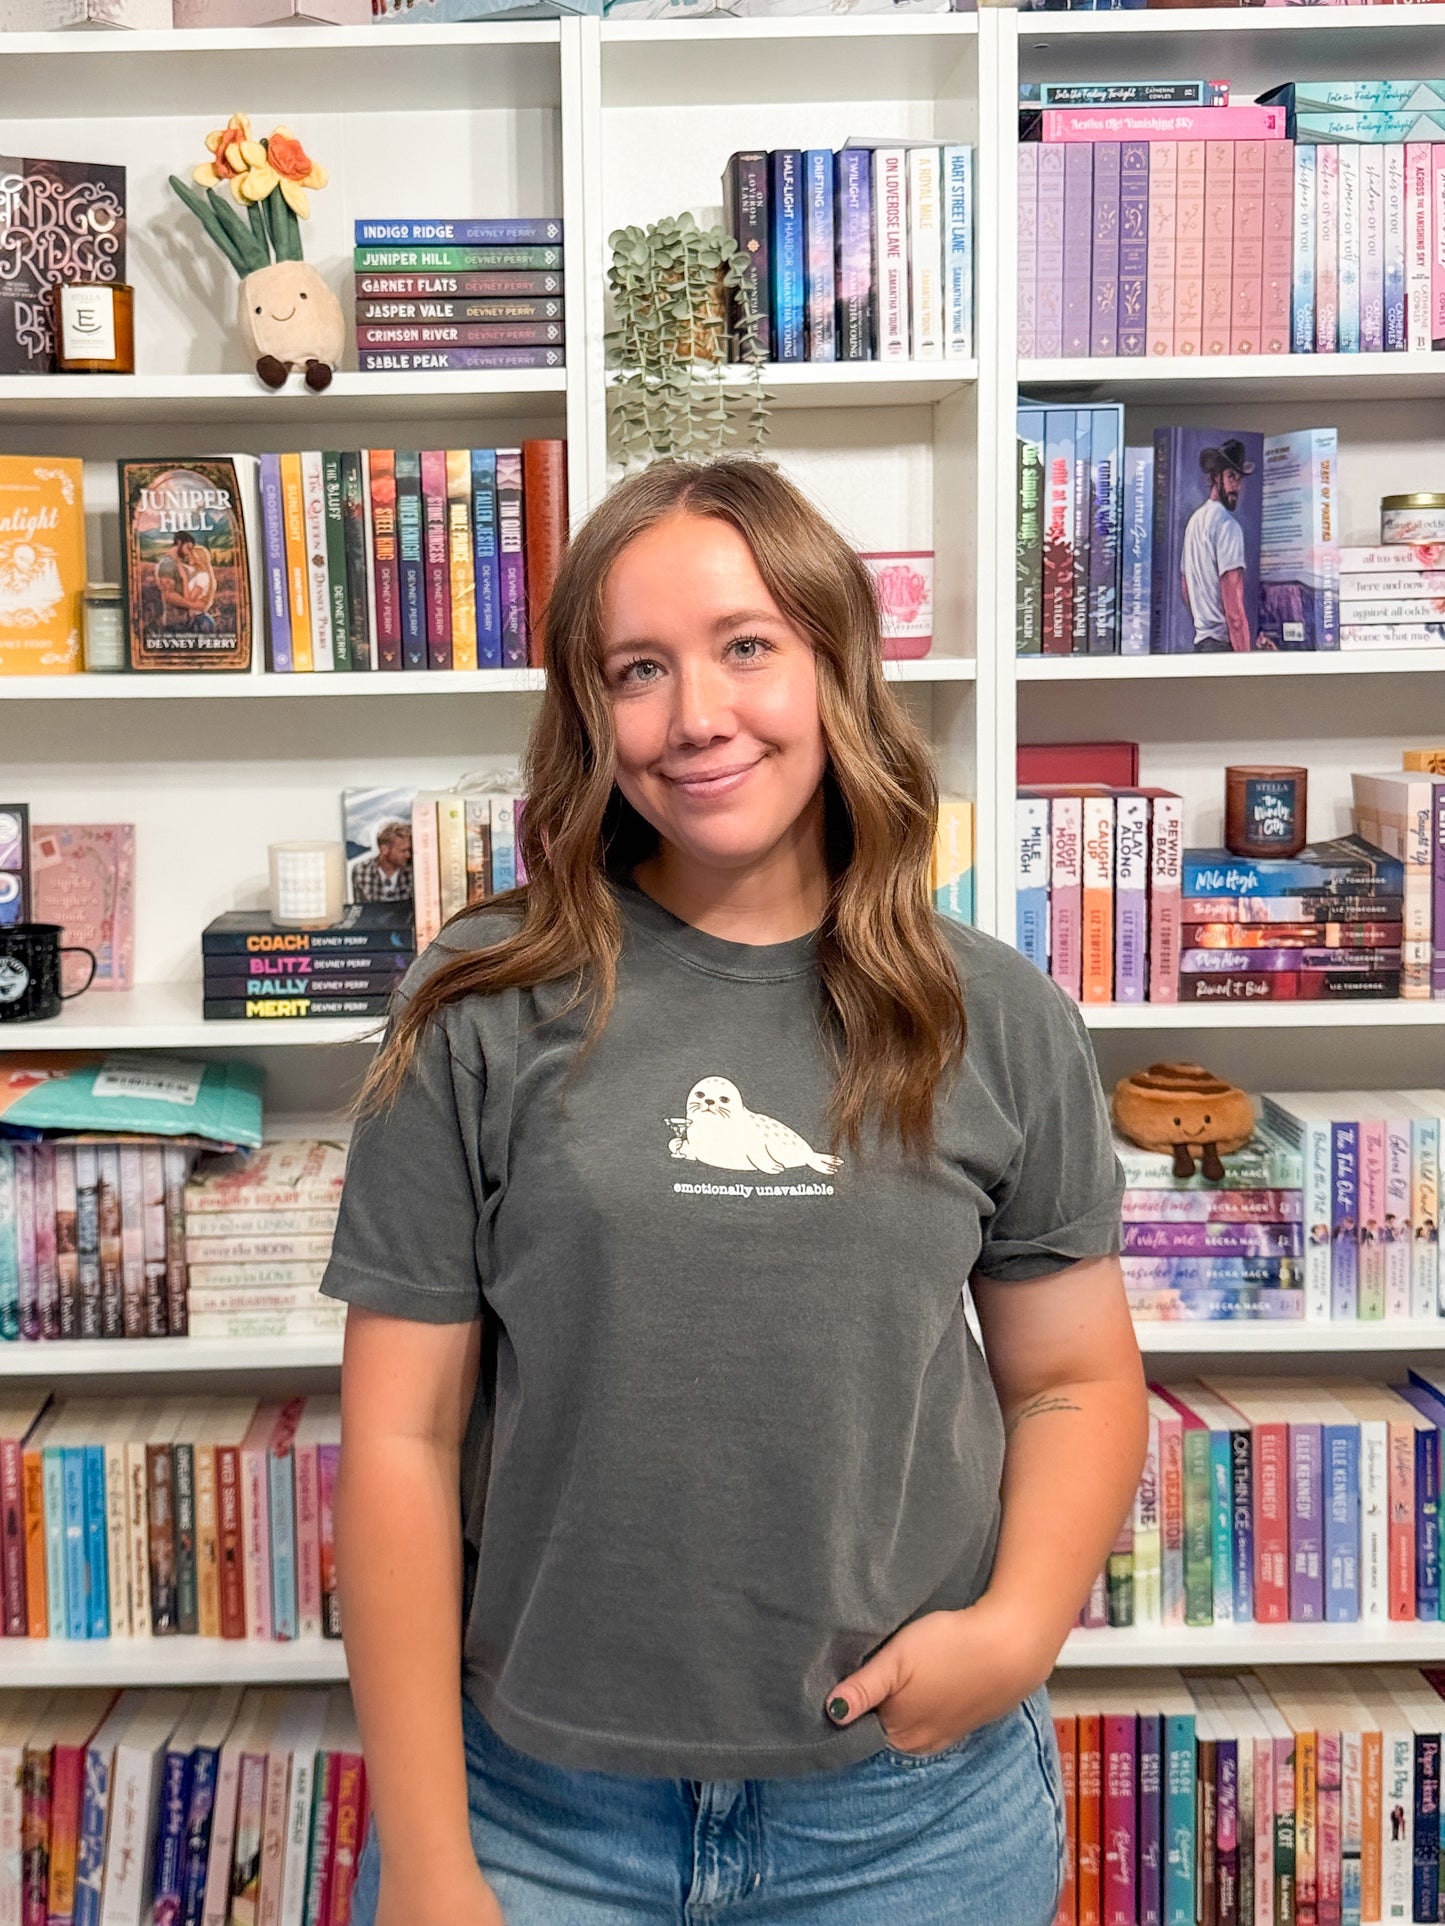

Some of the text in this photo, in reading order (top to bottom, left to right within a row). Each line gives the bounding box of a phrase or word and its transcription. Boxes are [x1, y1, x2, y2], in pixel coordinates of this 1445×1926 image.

[1071, 119, 1104, 130] Across
[1124, 118, 1174, 130] Vanishing
[1175, 117, 1194, 130] Sky
[814, 156, 824, 244] DRIFTING DAWN
[848, 156, 860, 208] TWILIGHT
[918, 167, 932, 198] ROYAL
[0, 174, 123, 235] INDIGO
[784, 154, 794, 266] HALF-LIGHT HARBOR
[886, 158, 900, 258] ON LOVEROSE LANE
[920, 200, 932, 230] MILE
[952, 156, 964, 254] HART STREET LANE
[1416, 167, 1426, 268] ACROSS VANISHING SKY
[363, 225, 536, 238] INDIGO RIDGE DEVNEY PERRY
[0, 226, 118, 285] RIDGE
[362, 252, 534, 266] JUNIPER HILL DEVNEY PERRY
[362, 279, 534, 292] GARNET FLATS DEVNEY PERRY
[784, 272, 792, 322] SAMANTHA
[888, 269, 900, 336] SAMANTHA YOUNG
[952, 267, 962, 334] SAMANTHA YOUNG
[365, 304, 536, 318] JASPER VALE DEVNEY PERRY
[366, 329, 536, 342] CRIMSON RIVER DEVNEY PERRY
[367, 356, 536, 369] SABLE PEAK DEVNEY PERRY
[1022, 467, 1039, 509] simple
[1052, 458, 1068, 484] wild
[1098, 460, 1111, 509] running
[138, 489, 232, 512] JUNIPER
[287, 484, 301, 542] SUNLIGHT
[0, 507, 59, 541] nlight
[159, 511, 214, 532] HILL
[266, 484, 280, 558] CROSSROADS
[327, 483, 346, 621] BLUFF DEVNEY
[374, 507, 395, 605] STEEL KING DEVNEY
[477, 523, 494, 601] JESTER DEVNEY
[501, 519, 521, 603] QUEEN DEVNEY
[1362, 553, 1413, 564] all too well
[407, 570, 417, 604] DEVNEY
[433, 569, 443, 605] DEVNEY
[1357, 580, 1424, 592] here and now
[1353, 606, 1430, 621] against all odds
[146, 639, 238, 650] DEVNEY PERRY
[1384, 630, 1409, 641] what
[1256, 783, 1288, 792] STELLA
[1254, 804, 1290, 821] Windy
[1264, 818, 1284, 836] City
[1410, 809, 1430, 849] Caught
[1020, 839, 1032, 874] HIGH
[1030, 826, 1042, 860] MILE
[1056, 827, 1066, 868] MOVE
[1066, 833, 1076, 878] RIGHT
[1088, 840, 1098, 860] UP
[1098, 819, 1109, 880] CAUGHT
[1120, 825, 1132, 878] ALONG
[1132, 820, 1144, 858] PLAY
[1156, 837, 1167, 876] BACK
[1168, 819, 1179, 878] REWIND
[1195, 869, 1258, 894] Mile High
[246, 934, 368, 951] COACH DEVNEY PERRY
[1195, 952, 1220, 970] Play
[250, 958, 372, 974] BLITZ DEVNEY PERRY
[246, 978, 370, 995] RALLY DEVNEY PERRY
[246, 999, 368, 1018] MERIT DEVNEY PERRY
[1366, 1134, 1382, 1156] The
[1390, 1134, 1408, 1174] Gloves
[1420, 1128, 1434, 1182] The Wild
[1337, 1128, 1356, 1212] The Out
[673, 1182, 835, 1198] emotionally unavailable
[1206, 1203, 1270, 1212] BECKA MACK
[1172, 1234, 1238, 1246] me BECKA
[1206, 1270, 1270, 1278] BECKA MACK
[1208, 1302, 1270, 1310] BECKA MACK
[1234, 1436, 1250, 1530] ON THIN ICE
[1262, 1434, 1277, 1520] ELLE KENNEDY
[1296, 1434, 1310, 1520] ELLE KENNEDY
[1332, 1439, 1347, 1524] ELLE KENNEDY
[1141, 1478, 1156, 1525] ZONE
[1064, 1752, 1074, 1796] CHLOE
[1089, 1751, 1102, 1796] CHLOE
[1108, 1753, 1119, 1796] WALSH
[1118, 1752, 1132, 1797] CHLOE
[1150, 1753, 1160, 1792] CHLOE
[1169, 1751, 1179, 1794] WALSH
[1180, 1750, 1192, 1794] CHLOE
[1418, 1742, 1438, 1778] Paper
